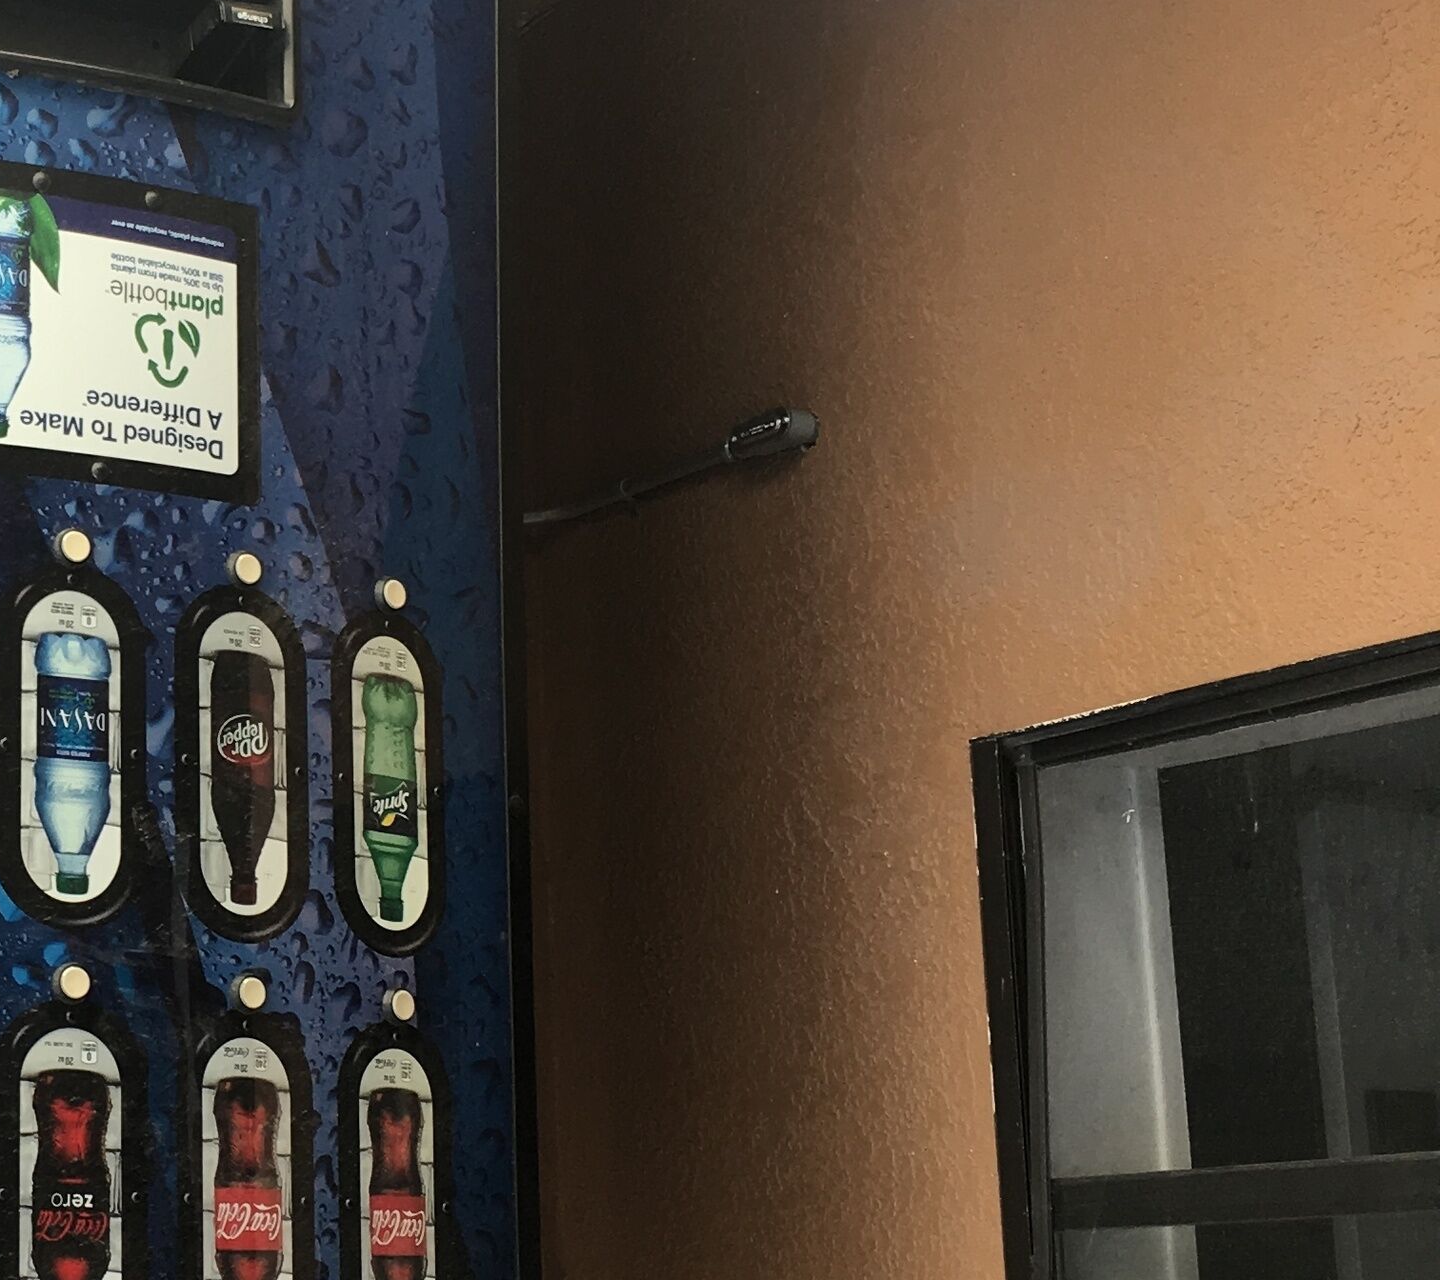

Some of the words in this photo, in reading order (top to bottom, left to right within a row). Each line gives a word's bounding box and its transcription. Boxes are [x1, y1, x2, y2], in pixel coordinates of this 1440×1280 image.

[237, 12, 268, 23] change
[111, 253, 135, 264] bottle
[138, 258, 179, 272] recyclable
[111, 263, 136, 274] plants
[138, 269, 156, 279] from
[181, 266, 200, 276] 100%
[159, 273, 181, 283] made
[184, 277, 200, 288] 30%
[209, 272, 223, 282] Still
[212, 283, 223, 293] Up
[110, 280, 224, 319] plantbottle
[86, 390, 200, 427] Difference
[20, 410, 83, 437] Make
[207, 410, 222, 430] A
[92, 420, 117, 442] To
[124, 425, 223, 460] Designed
[66, 620, 74, 629] 20
[41, 707, 105, 734] DASANI
[221, 720, 268, 755] Pepper
[231, 739, 251, 757] Dr
[373, 790, 409, 816] Sprite
[65, 1057, 74, 1066] 20
[51, 1193, 93, 1208] zero
[36, 1210, 107, 1241] Coca-Cola
[217, 1203, 281, 1240] Coca-Cola
[372, 1210, 425, 1246] Coca-Cola
